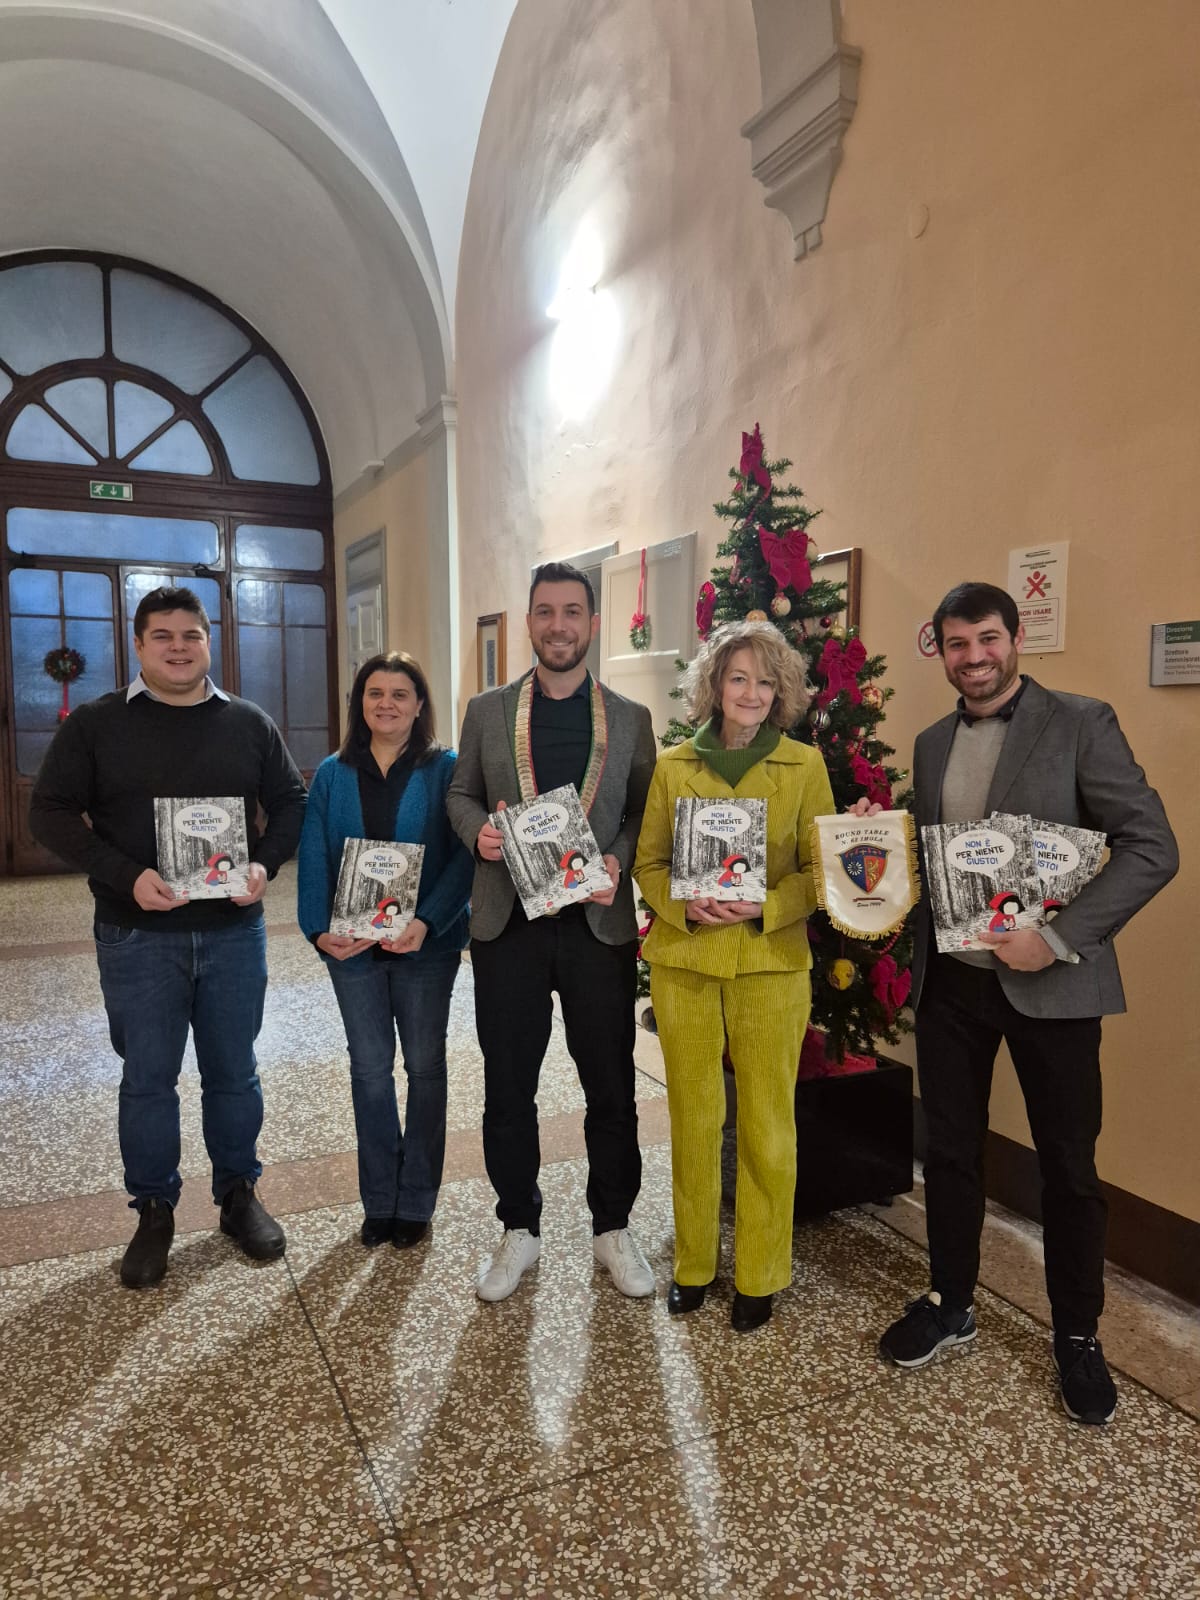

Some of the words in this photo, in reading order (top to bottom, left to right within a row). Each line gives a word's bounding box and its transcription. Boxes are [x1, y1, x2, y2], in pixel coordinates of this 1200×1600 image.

[199, 817, 223, 825] NIENTE
[522, 824, 536, 835] PER
[537, 812, 561, 828] NIENTE
[527, 815, 542, 824] NON
[835, 830, 861, 840] ROUND
[965, 840, 982, 849] NON
[955, 850, 972, 860] PER
[975, 845, 1005, 857] NIENTE
[1038, 850, 1069, 862] NIENTE
[379, 861, 401, 869] NIENTE
[966, 857, 999, 866] GIUSTO!
